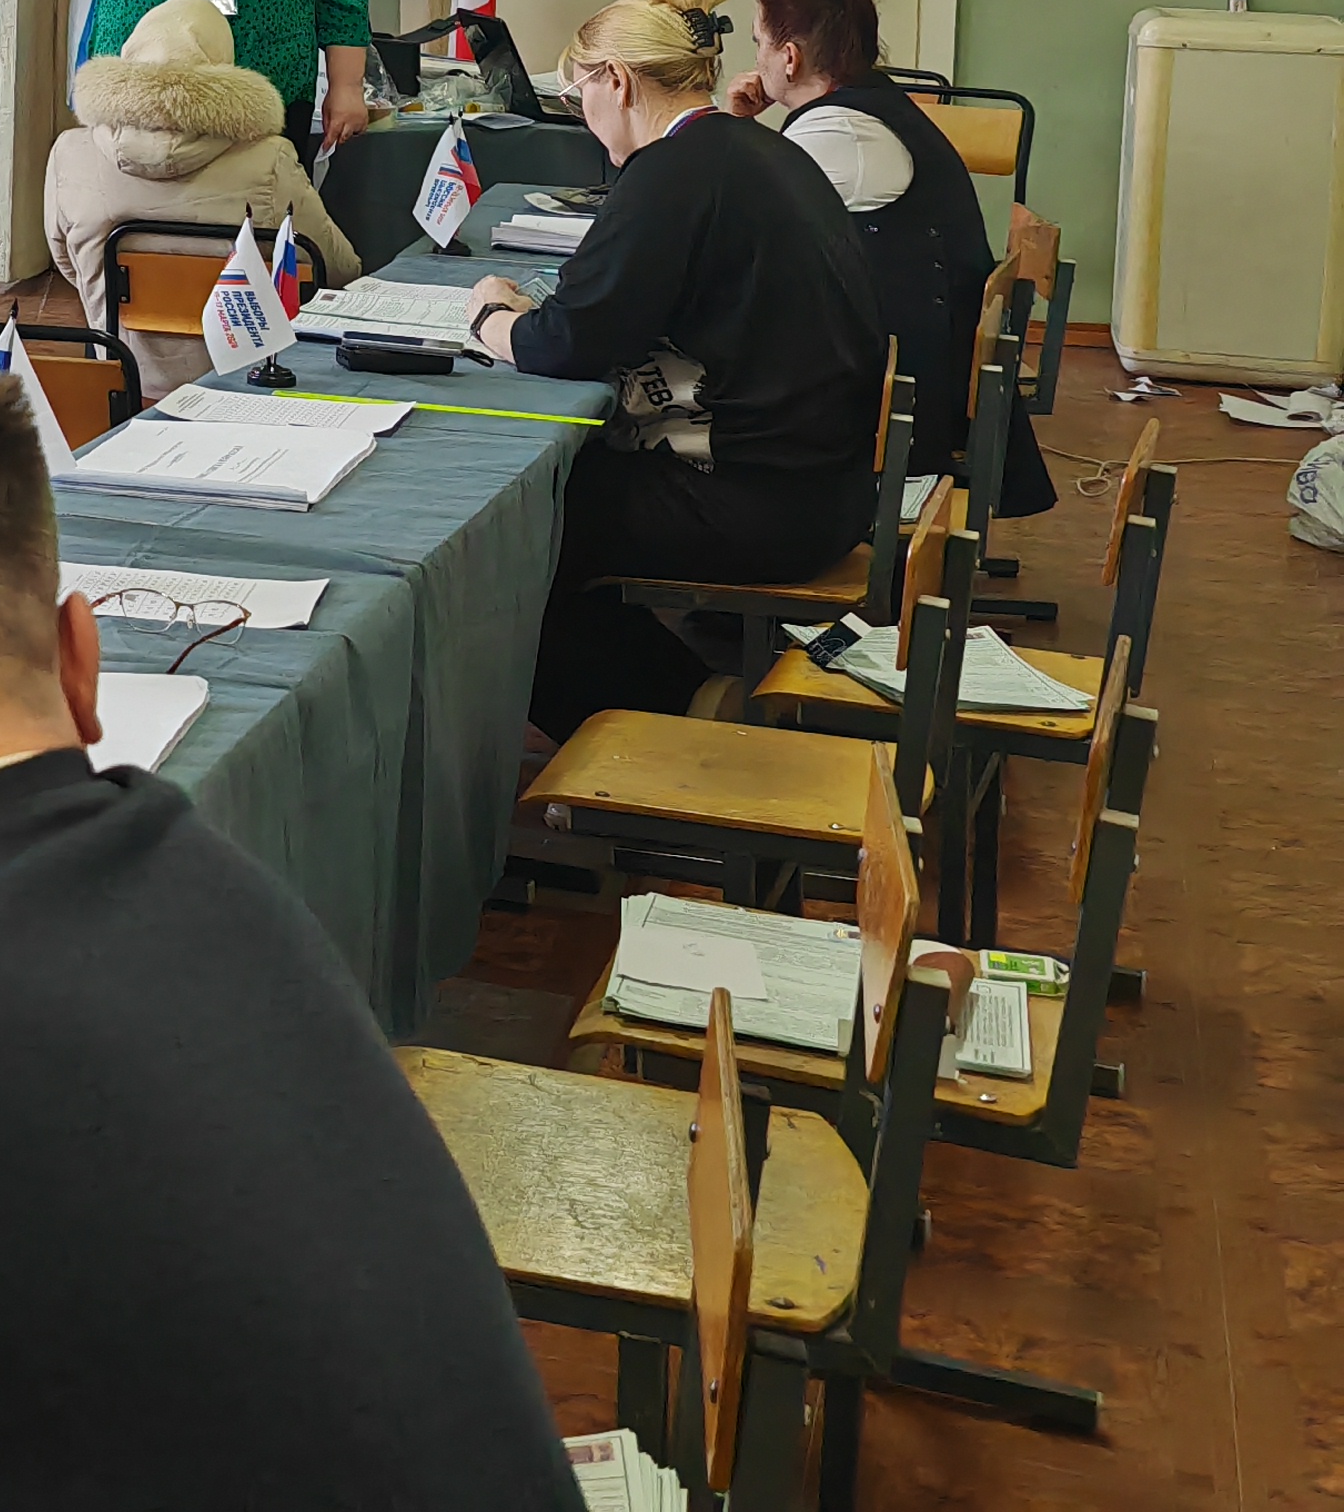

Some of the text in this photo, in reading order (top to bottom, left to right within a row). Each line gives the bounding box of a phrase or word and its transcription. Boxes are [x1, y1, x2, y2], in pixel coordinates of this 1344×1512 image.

[221, 290, 242, 327] РОССИИ
[232, 290, 265, 348] ПРЕЗИДЕНТА
[244, 290, 270, 331] ВЫБОРЫ
